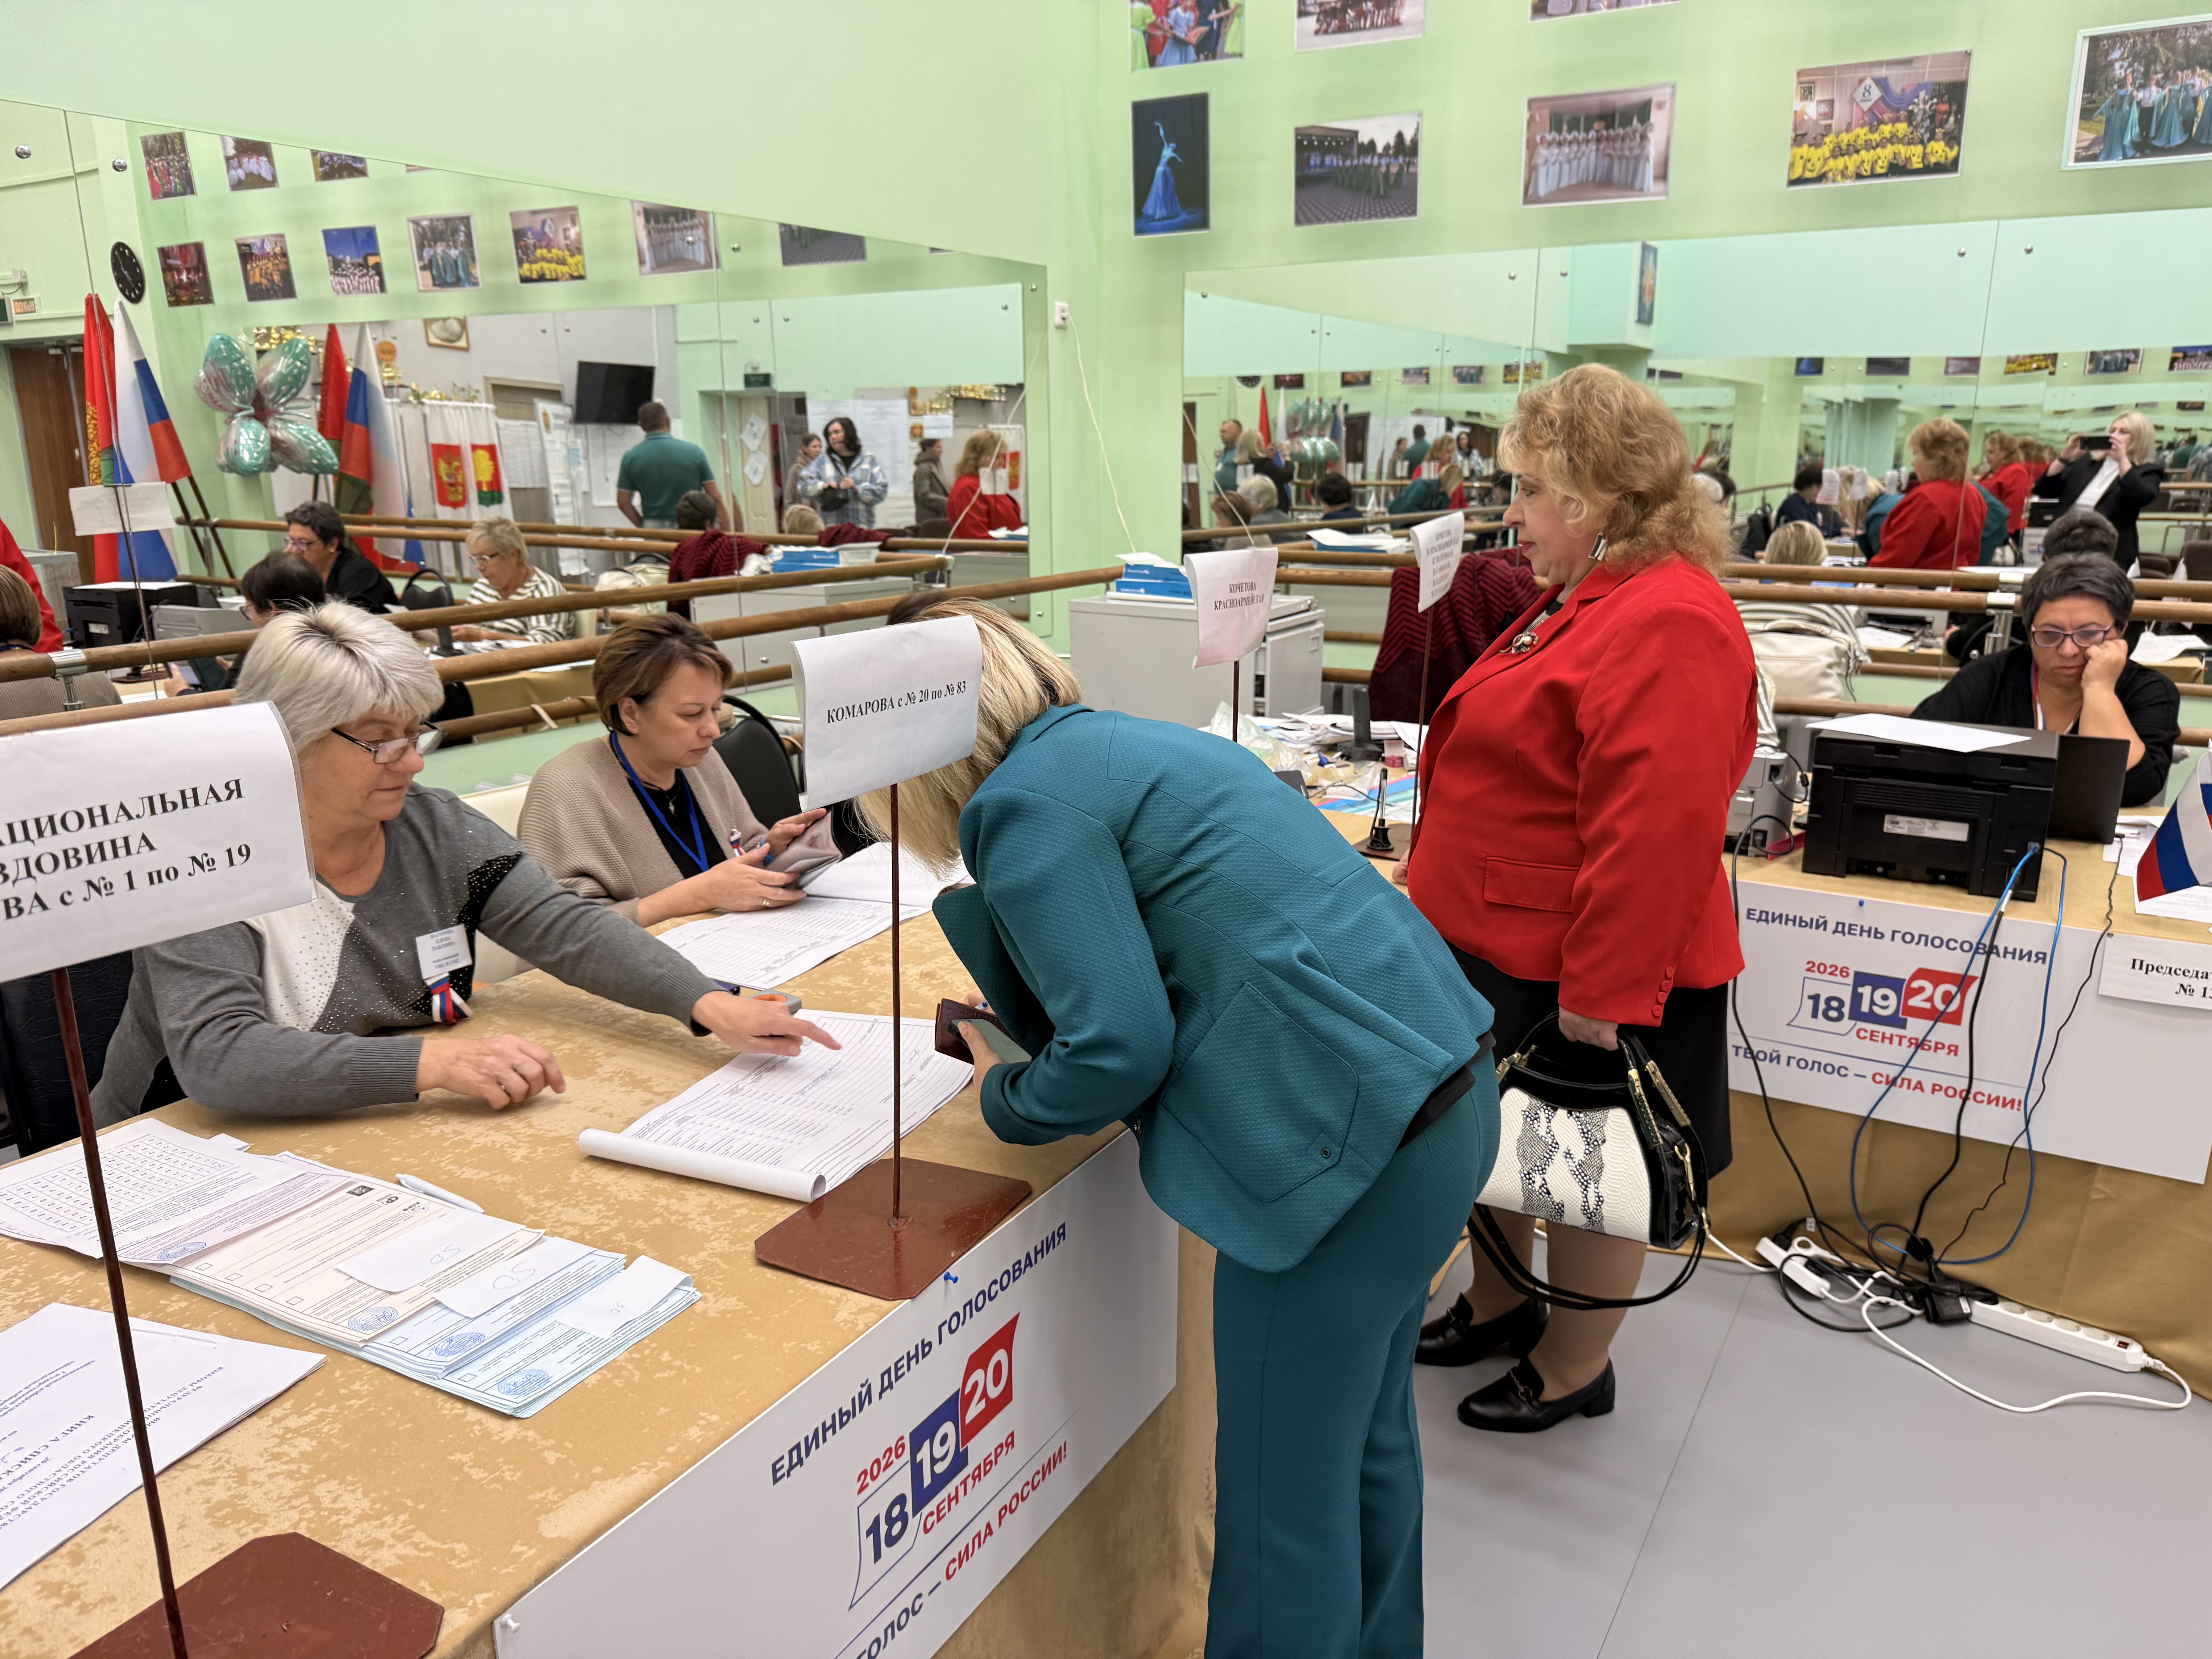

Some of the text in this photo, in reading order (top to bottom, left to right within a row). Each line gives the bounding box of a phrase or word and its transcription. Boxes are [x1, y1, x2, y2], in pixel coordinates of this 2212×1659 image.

[1863, 84, 1871, 98] 8
[1214, 594, 1264, 610] КРАСНОАРМЕЙСКАЯ
[1229, 582, 1256, 593] КОЧЕТОВА
[828, 681, 966, 723] КОМАРОВА с № 20 по № 83
[0, 778, 245, 846] ЦИОНАЛЬНАЯ
[1, 844, 251, 920] ВА с № 1 по № 19
[1747, 908, 2047, 965] ЕДИНЫЙ ДЕНЬ ГОЛОСОВАНИЯ
[1805, 960, 1850, 979] 2026
[2131, 958, 2212, 980] Председа
[1807, 981, 1960, 1022] 18 19 20
[2175, 983, 2194, 996] №
[1856, 1027, 1959, 1058] СЕНТЯБРЯ
[1733, 1044, 1781, 1066] ТВОЙ
[1786, 1054, 1849, 1077] ГОЛОС
[1872, 1070, 1925, 1094] СИЛА
[1931, 1082, 2021, 1112] РОССИИ!
[493, 1261, 535, 1290] 50
[771, 1222, 1065, 1486] ЕДИНЫЙ ДЕНЬ ГОЛОСОВАНИЯ
[188, 1367, 224, 1386] ВЫБОРЫ
[141, 1387, 188, 1413] ДЕПУТАТО
[142, 1386, 203, 1420] ФЕДЕРАЛЬНОГ
[49, 1415, 95, 1442] КНИГА
[82, 1419, 135, 1453] ИПЕЦКОГО
[121, 1418, 161, 1443] ВЫРЫ
[66, 1444, 122, 1482] ДЕПУТАТОВ
[857, 1436, 905, 1495] 2026
[866, 1348, 1008, 1564] 18 19 20
[17, 1455, 81, 1499] ОБЛАСТНОГО
[20, 1460, 87, 1505] РОССИЙСКОЙ
[923, 1430, 1015, 1535] СЕНТЯБРЯ
[945, 1522, 993, 1580] СИЛА
[998, 1441, 1066, 1528] РОССИИ!
